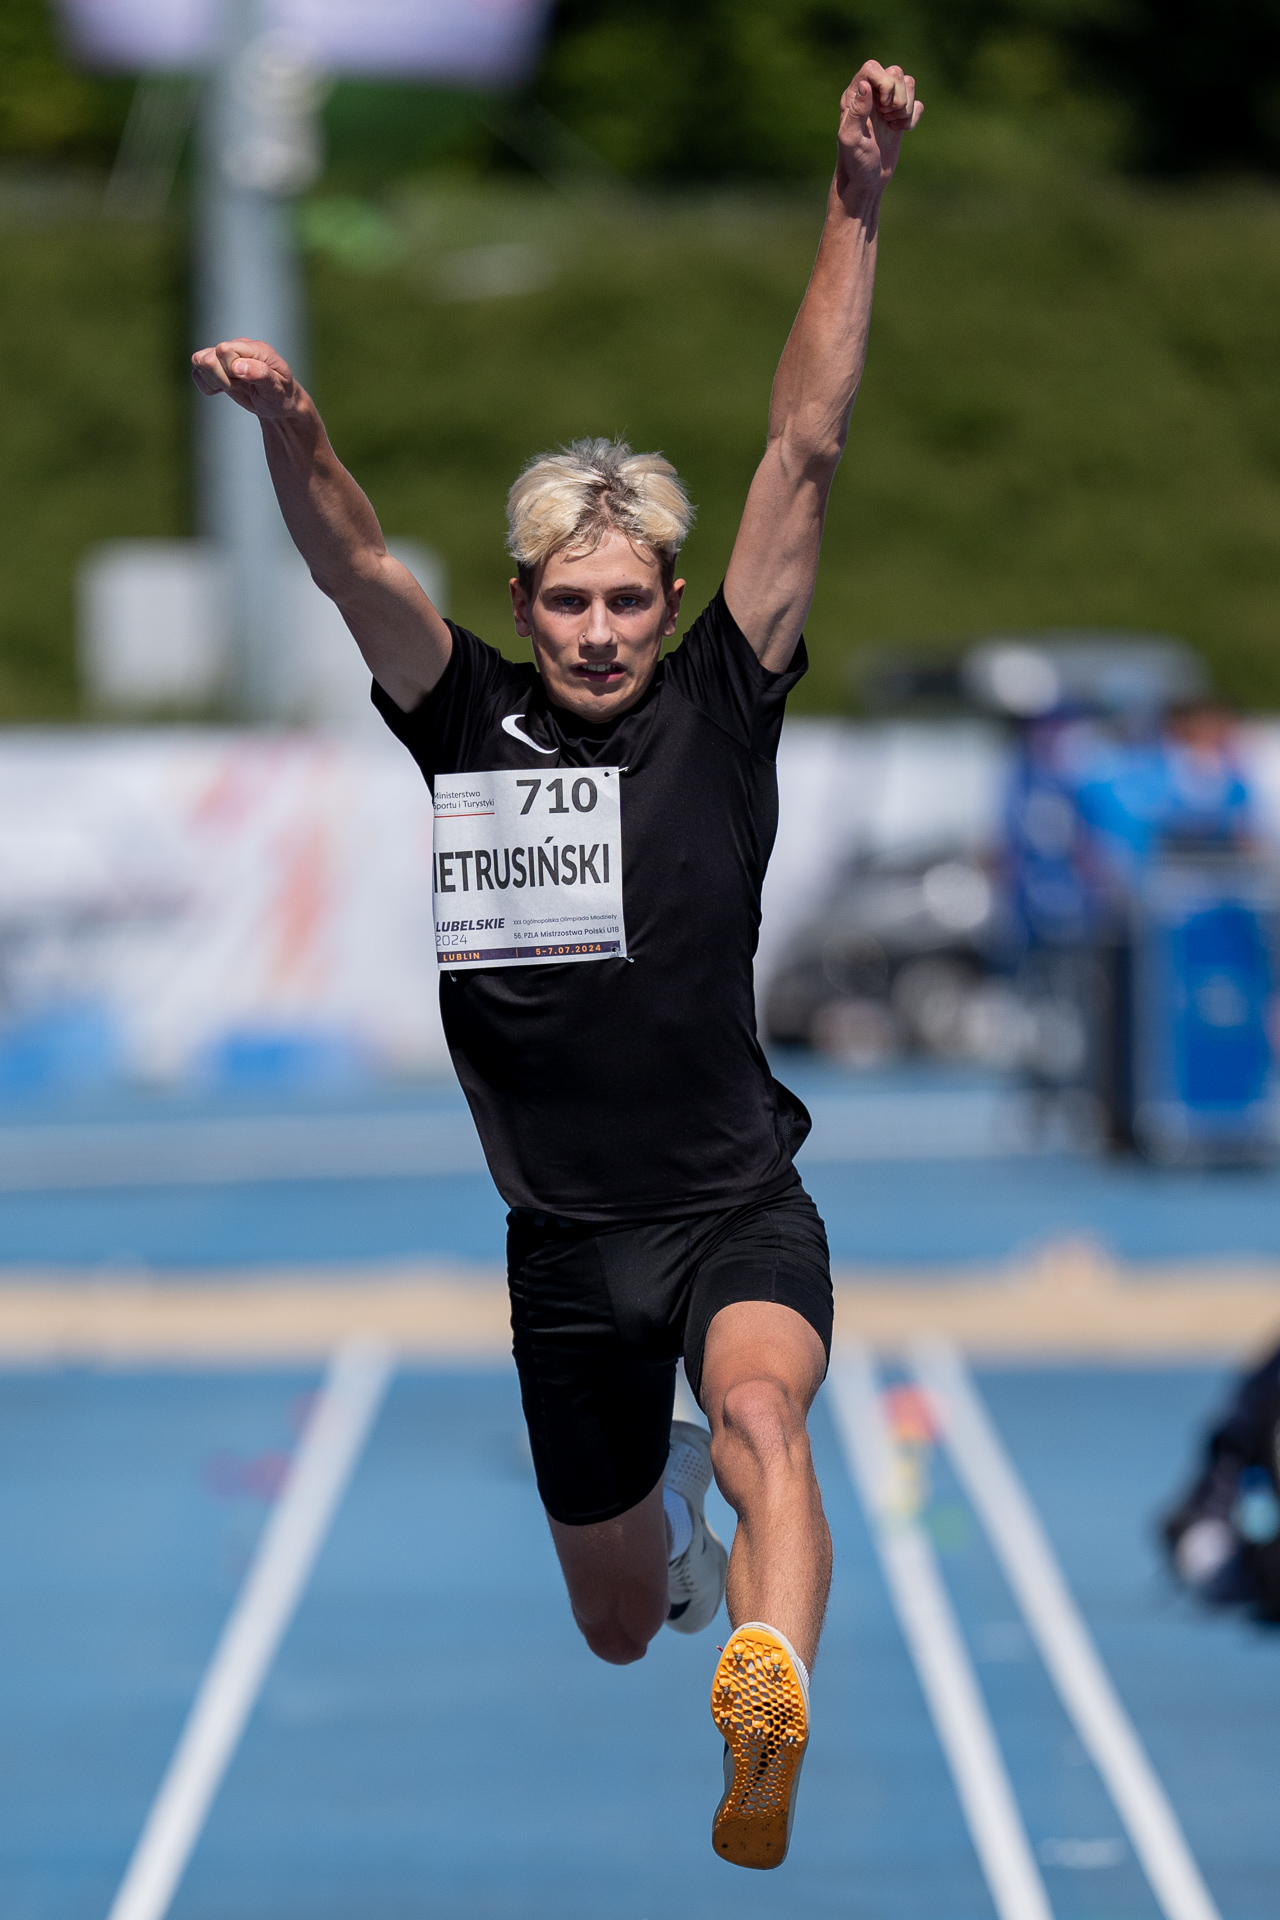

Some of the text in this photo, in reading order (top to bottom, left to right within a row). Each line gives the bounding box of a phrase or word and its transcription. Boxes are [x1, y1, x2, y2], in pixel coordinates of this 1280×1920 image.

[433, 790, 481, 800] Ministerstwo
[516, 777, 598, 815] 710
[433, 801, 457, 811] Sportu
[463, 798, 495, 808] Turystyki
[436, 918, 506, 932] LUBELSKIE
[559, 914, 590, 923] Olimpiada
[513, 932, 523, 940] 56.
[540, 929, 583, 938] Mistrzostwa
[584, 927, 606, 935] Polski
[606, 926, 620, 934] U18
[436, 934, 467, 947] 2024
[443, 944, 602, 962] LUBLIN 5-7.07.2024
